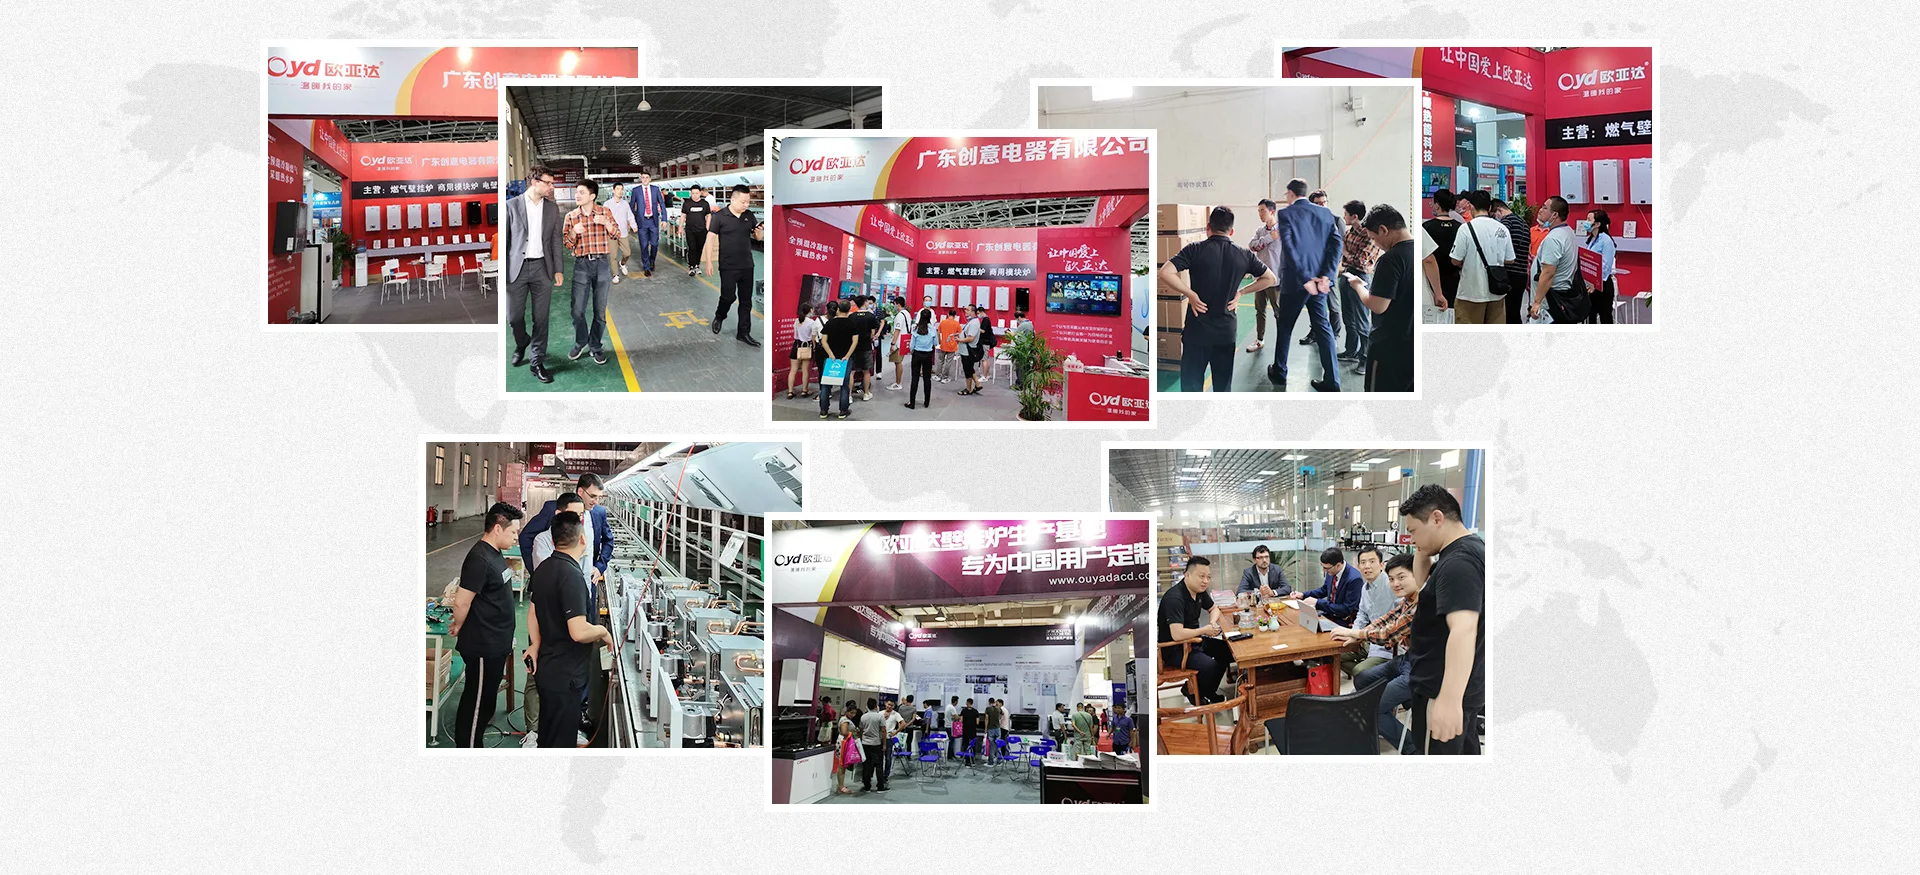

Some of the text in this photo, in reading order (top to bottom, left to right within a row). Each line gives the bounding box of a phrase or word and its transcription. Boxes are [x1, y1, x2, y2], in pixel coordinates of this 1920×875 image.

[1440, 47, 1533, 90] 让中国爱上欧亚达
[1600, 66, 1645, 84] 欧亚达
